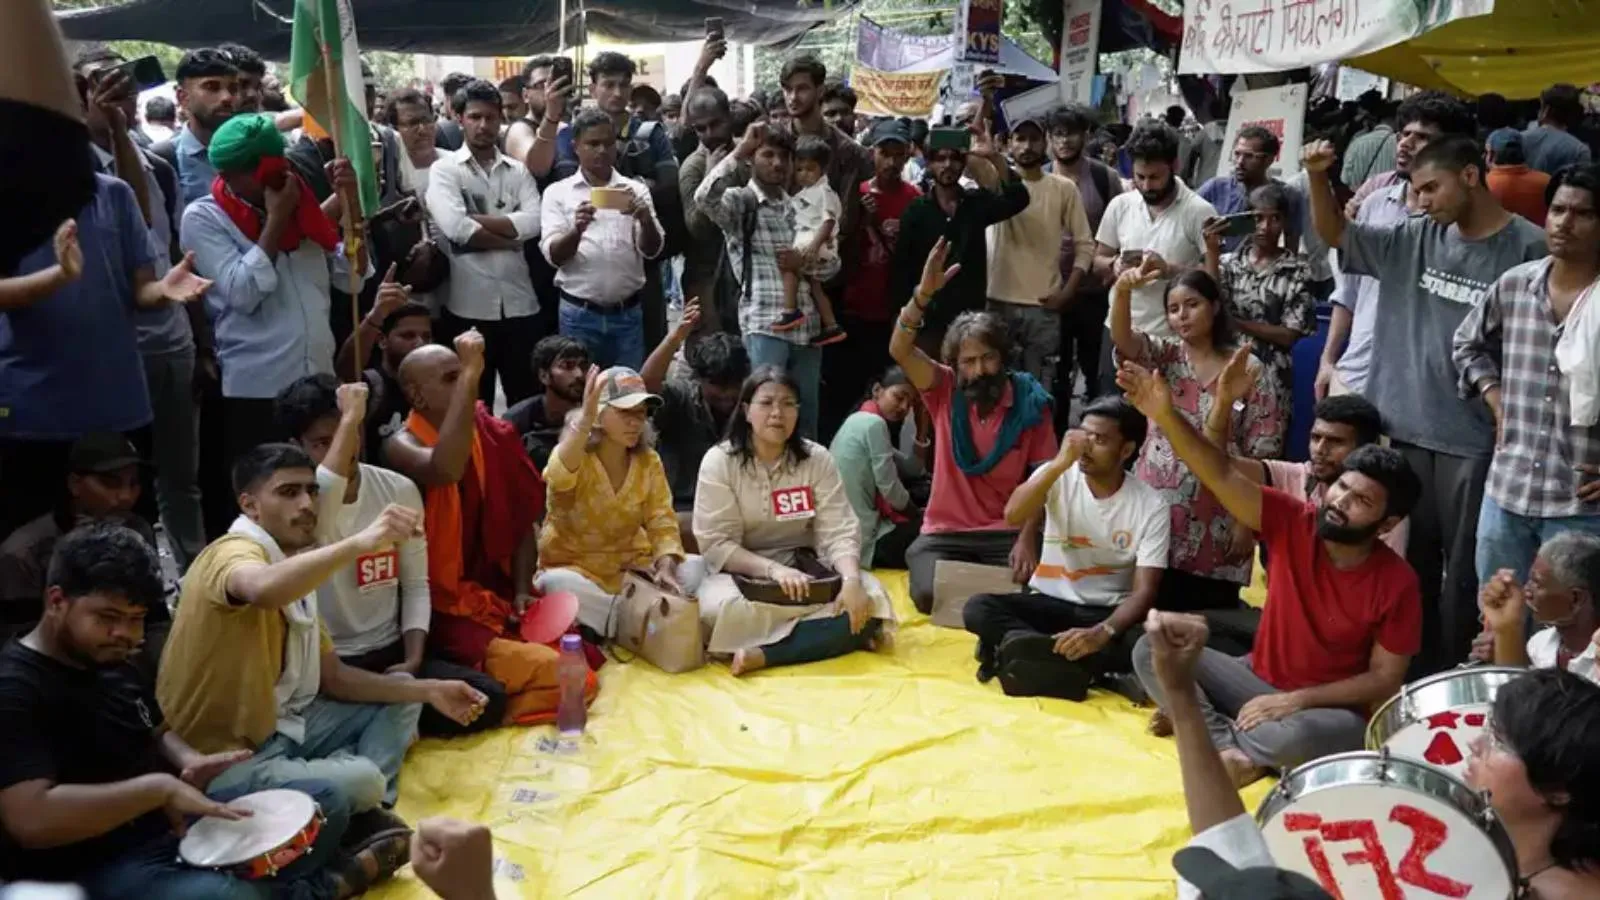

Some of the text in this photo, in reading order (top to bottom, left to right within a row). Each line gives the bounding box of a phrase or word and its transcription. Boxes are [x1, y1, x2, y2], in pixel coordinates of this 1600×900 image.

[967, 32, 999, 52] KYS
[1419, 272, 1486, 307] STARBO
[777, 490, 809, 513] SFI
[361, 555, 394, 583] SFI
